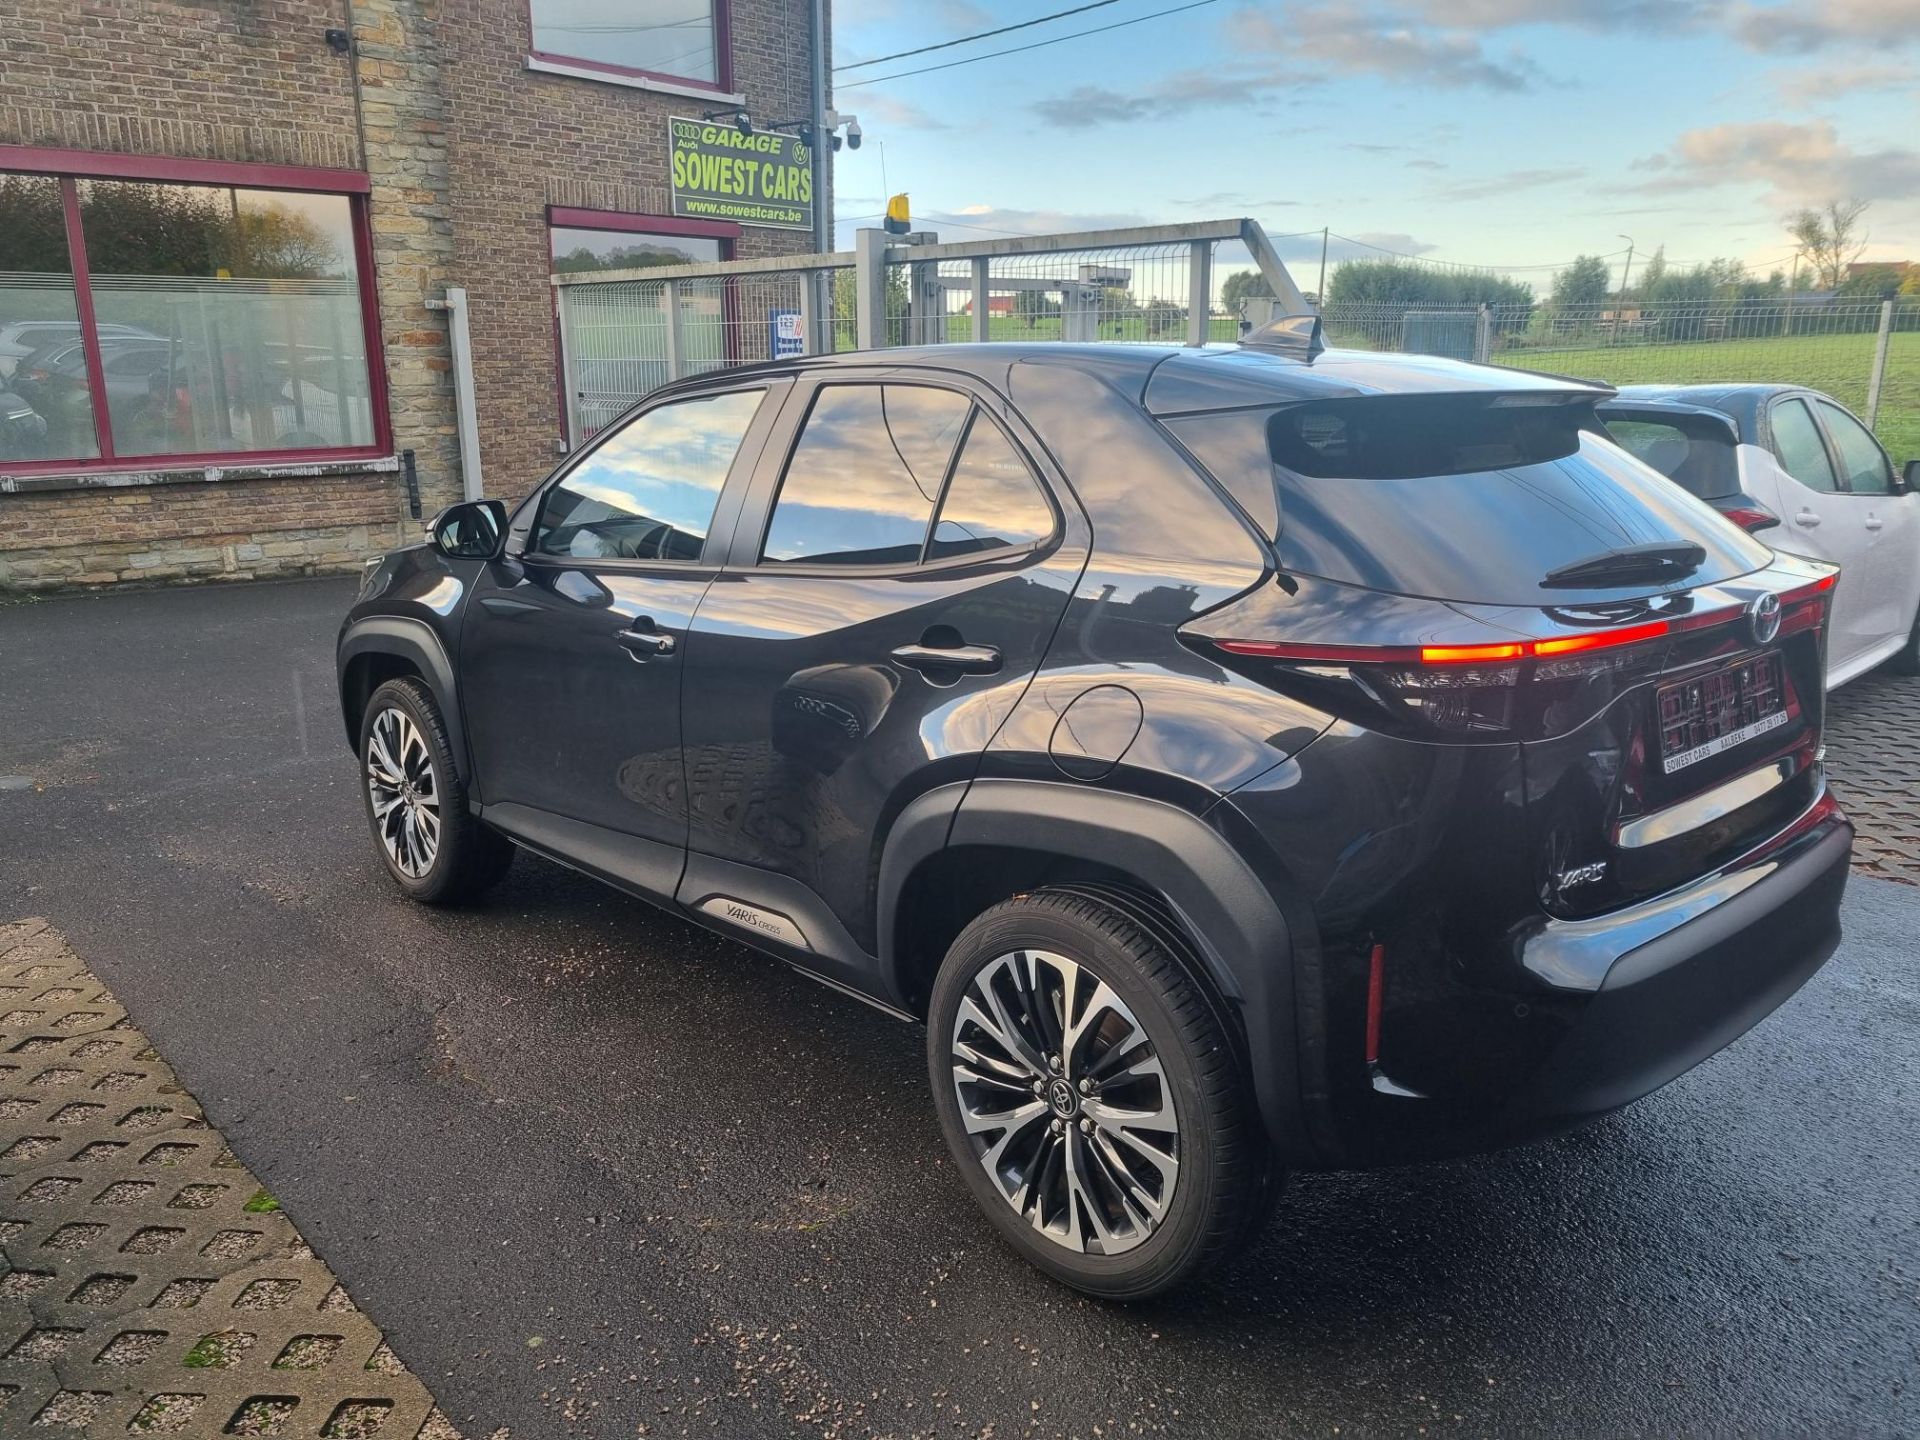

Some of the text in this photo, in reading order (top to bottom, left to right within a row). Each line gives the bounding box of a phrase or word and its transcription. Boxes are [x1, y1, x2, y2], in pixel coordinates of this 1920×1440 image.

[677, 139, 698, 150] Audi
[701, 127, 783, 155] GARAGE
[673, 150, 812, 203] SOWEST CARS
[686, 201, 802, 222] www.sowestcars.be
[1666, 752, 1692, 771] SOWEST
[1693, 745, 1711, 761] CARS
[758, 920, 781, 936] CROSS
